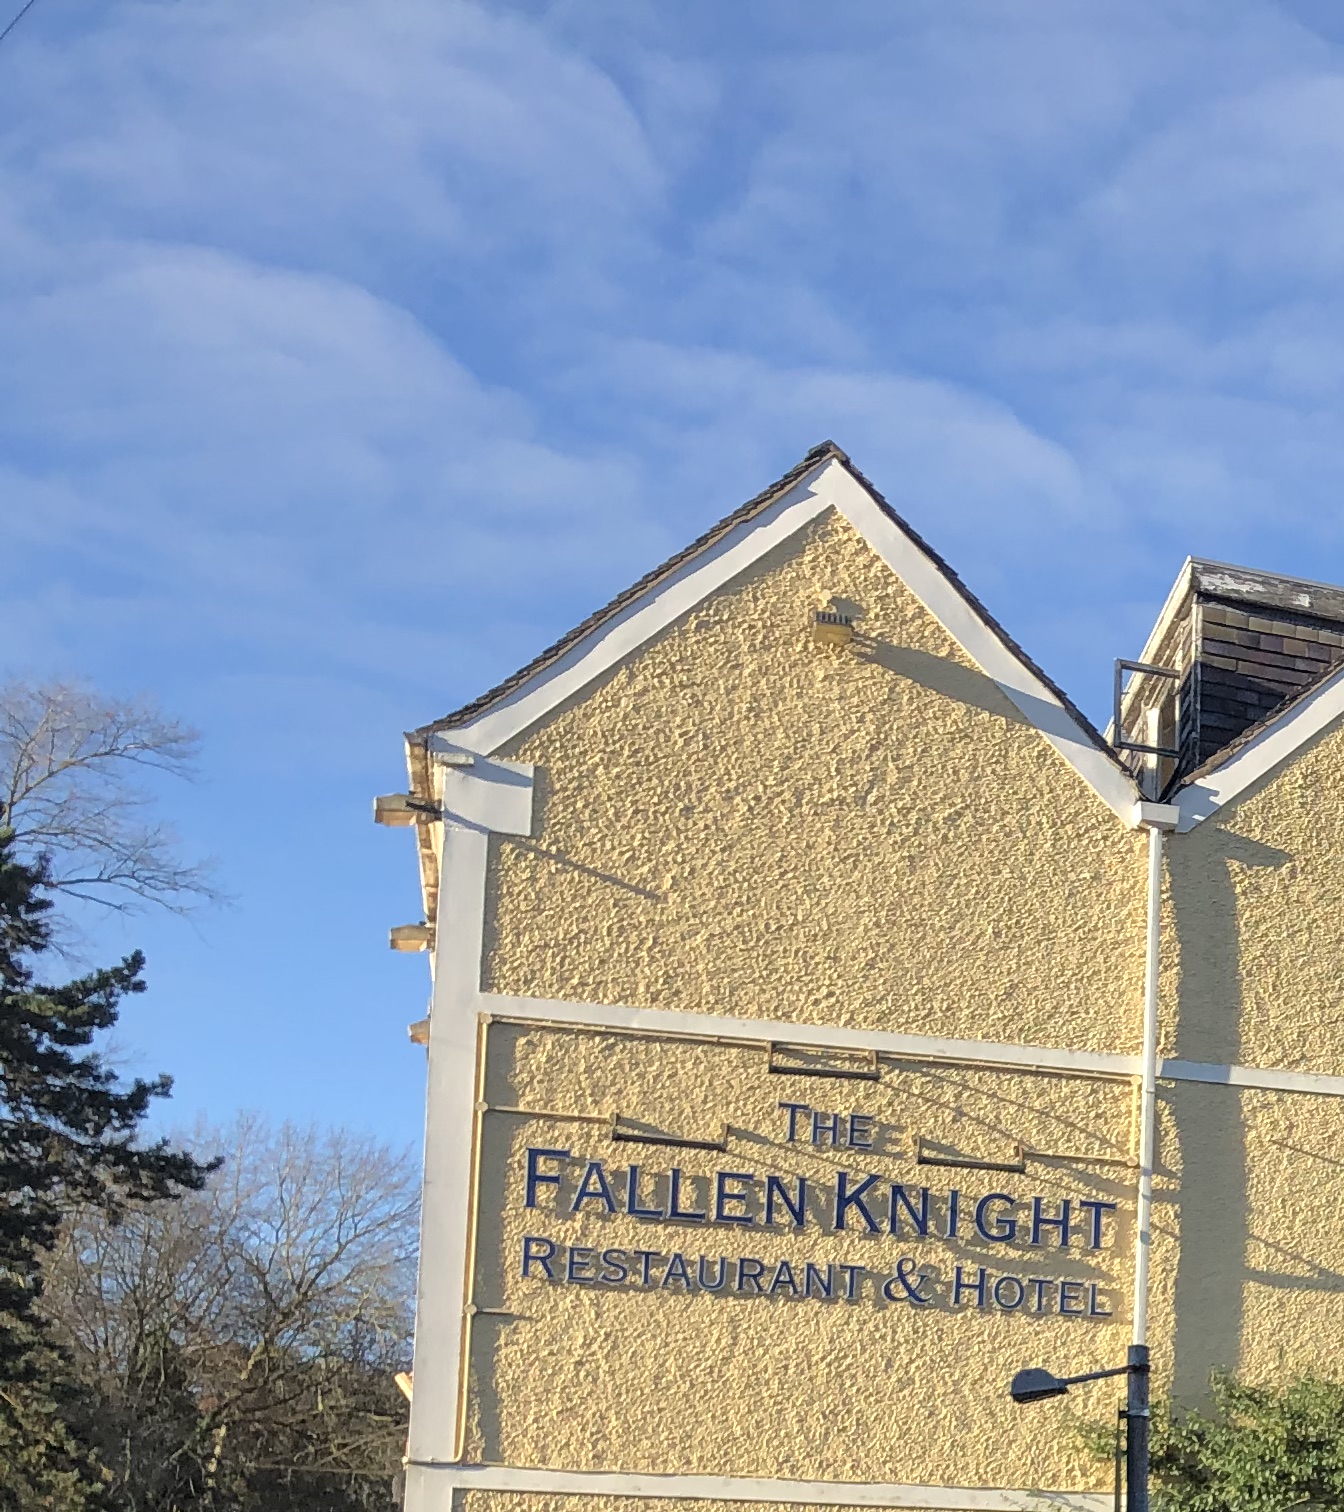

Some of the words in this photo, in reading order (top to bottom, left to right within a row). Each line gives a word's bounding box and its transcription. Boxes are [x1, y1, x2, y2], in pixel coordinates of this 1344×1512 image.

[778, 1102, 874, 1148] THE
[525, 1148, 806, 1227] FALLEN
[833, 1171, 1118, 1250] KNIGHT
[521, 1236, 865, 1299] RESTAURANT
[884, 1257, 932, 1304] &
[953, 1268, 1114, 1317] HOTEL
